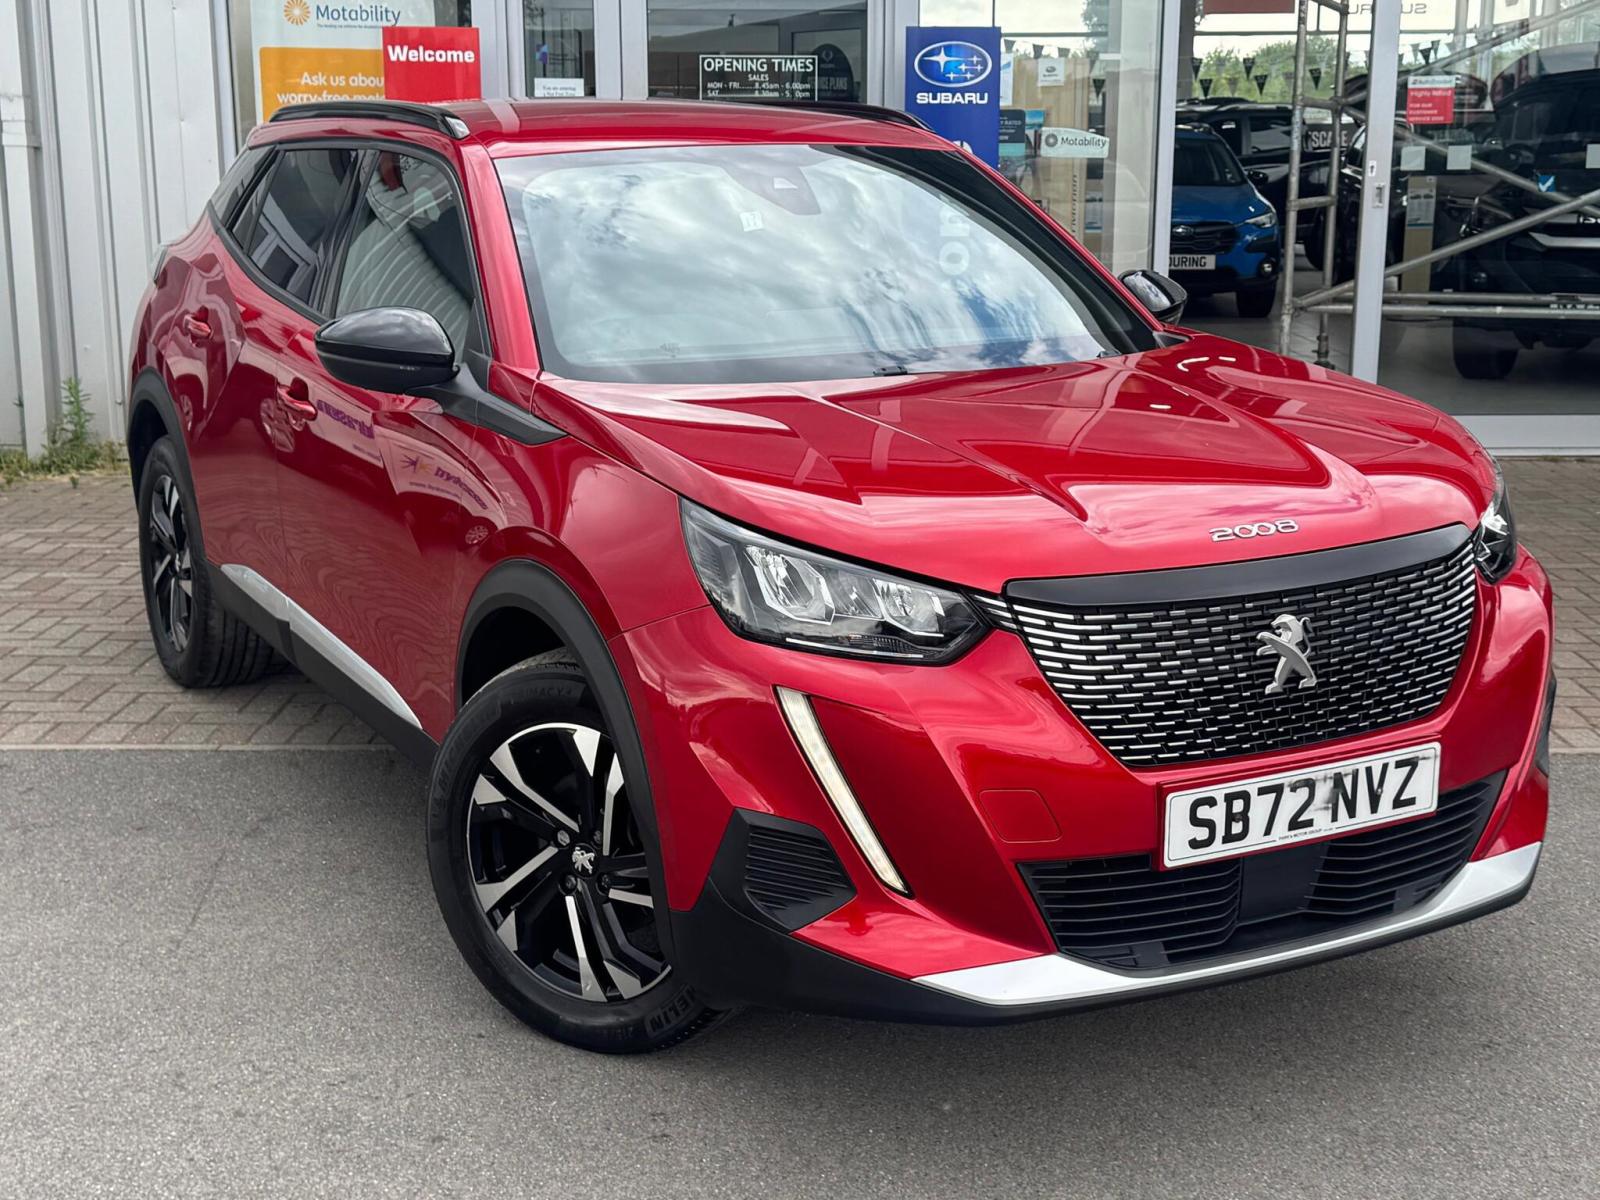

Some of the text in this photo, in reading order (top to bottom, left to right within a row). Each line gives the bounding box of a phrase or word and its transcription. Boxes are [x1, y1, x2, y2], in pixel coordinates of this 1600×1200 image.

[316, 5, 401, 27] Motability
[387, 45, 475, 63] Welcome
[703, 58, 768, 72] OPENING
[771, 58, 814, 72] TIMES
[300, 71, 384, 87] Ask us abou
[747, 74, 769, 82] SALES
[916, 92, 988, 104] SUBARU
[1060, 137, 1107, 149] Motability
[1209, 519, 1300, 542] 2008
[1188, 756, 1420, 850] SB72 NVZ
